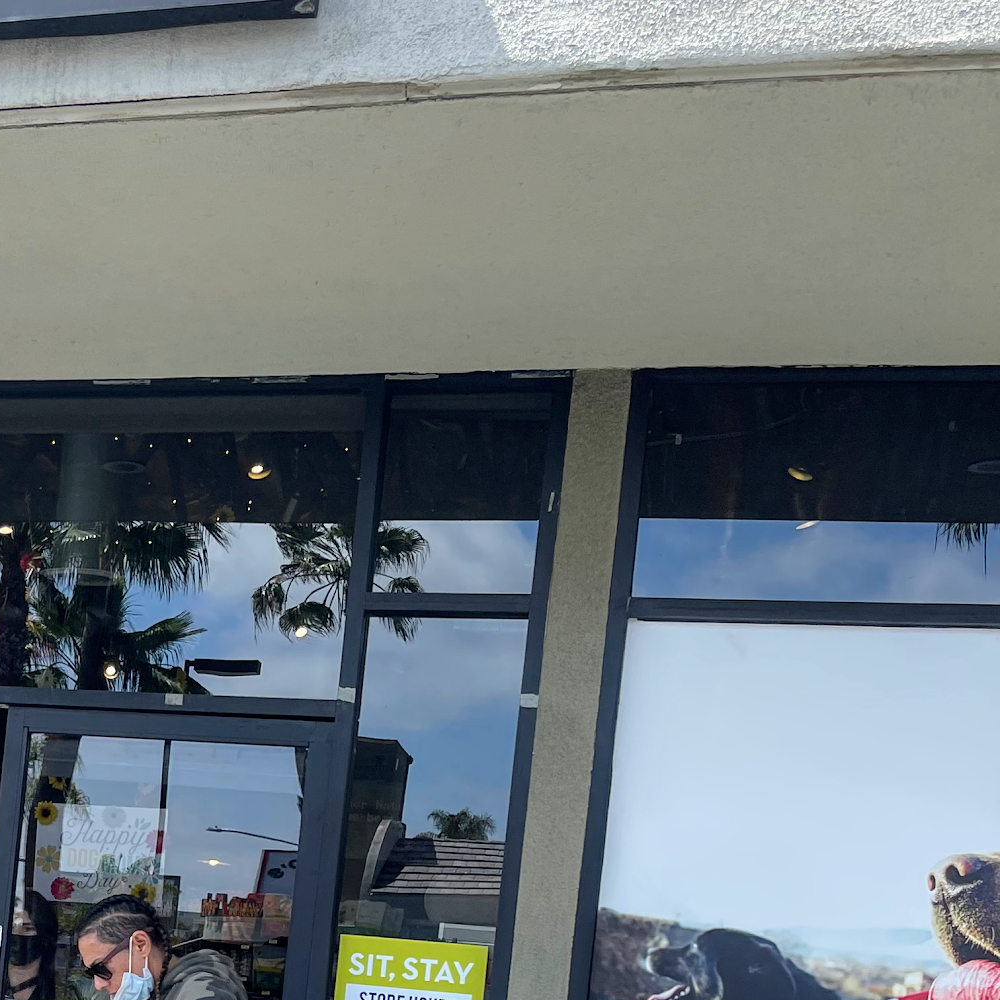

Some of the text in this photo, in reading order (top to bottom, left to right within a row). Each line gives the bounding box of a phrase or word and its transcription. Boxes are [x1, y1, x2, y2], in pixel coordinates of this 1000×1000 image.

[60, 817, 148, 854] Happy
[67, 847, 99, 869] DOG
[77, 870, 121, 894] Day
[348, 952, 475, 985] SIT, STAY
